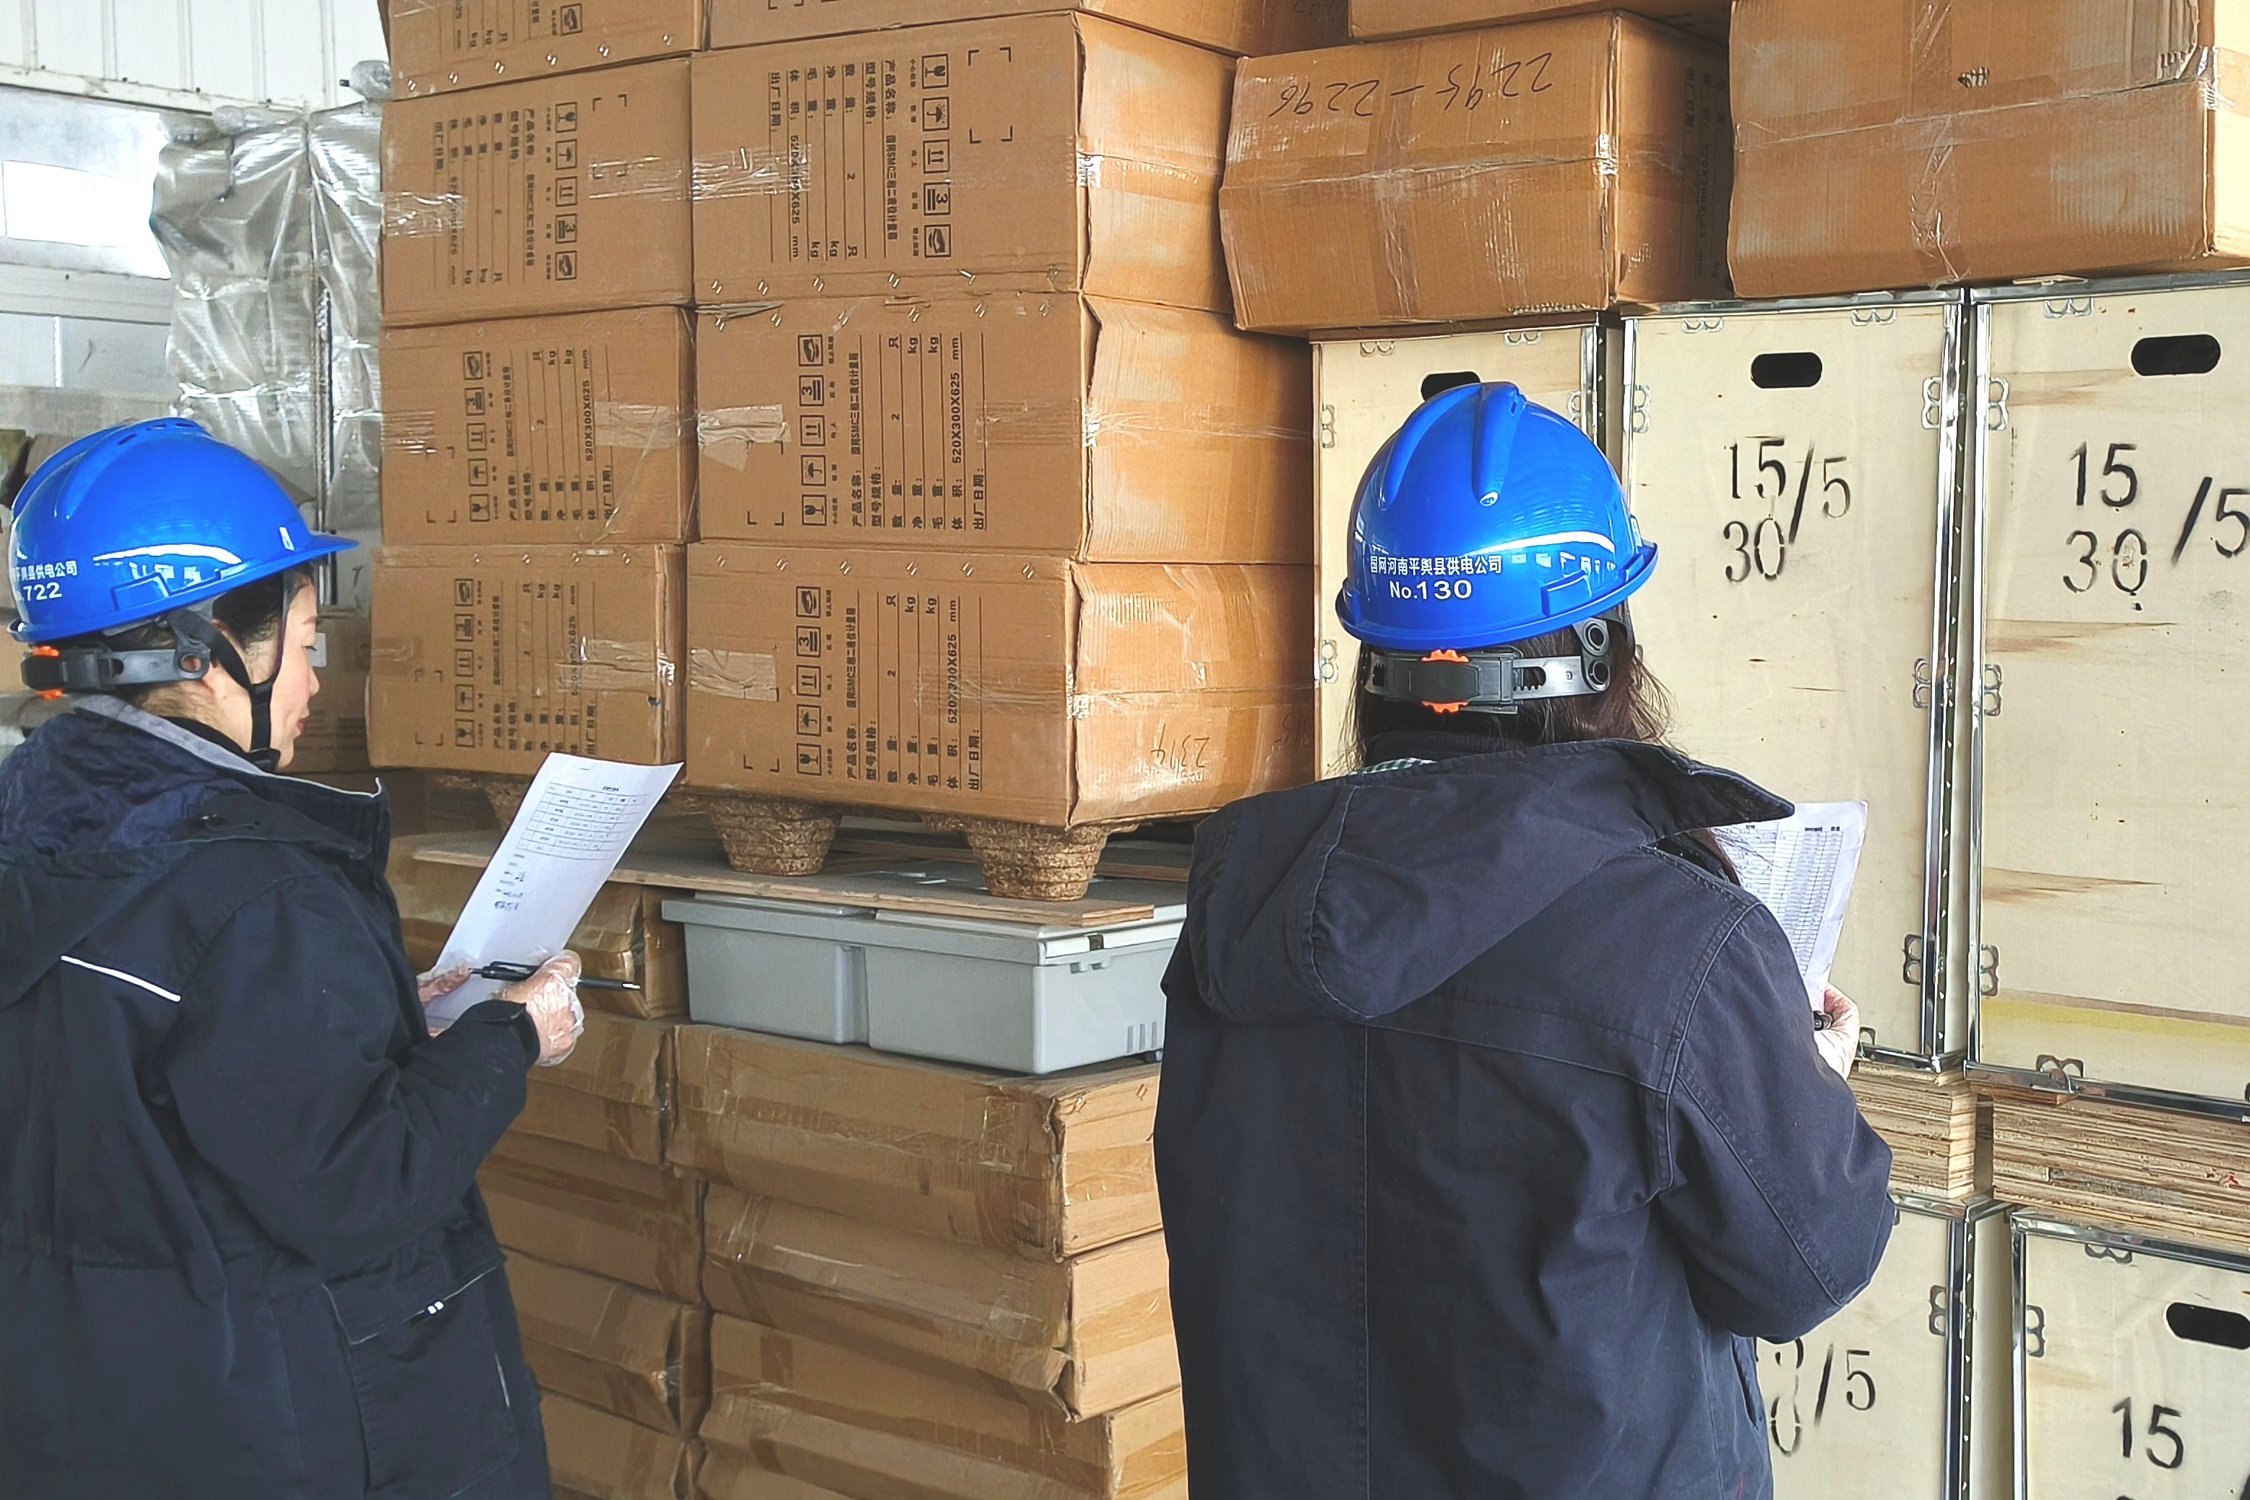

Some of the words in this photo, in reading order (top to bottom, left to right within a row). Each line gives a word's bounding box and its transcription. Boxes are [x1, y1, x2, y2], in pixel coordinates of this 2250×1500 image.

[847, 172, 856, 181] 2
[810, 241, 821, 259] kg
[829, 240, 840, 258] kg
[889, 337, 900, 349] 只
[908, 337, 919, 354] kg
[928, 336, 940, 354] kg
[951, 337, 960, 361] mm
[891, 413, 900, 421] 2
[950, 372, 961, 464] 520X300X625
[972, 467, 985, 530] 出厂日期：
[1723, 516, 1785, 582] 30
[23, 582, 62, 601] 722
[1389, 579, 1472, 600] No.130
[886, 594, 897, 607] 只
[904, 596, 916, 614] kg
[925, 597, 937, 615] kg
[949, 599, 957, 622] mm
[887, 669, 896, 678] 2
[2112, 1396, 2185, 1469] 15
